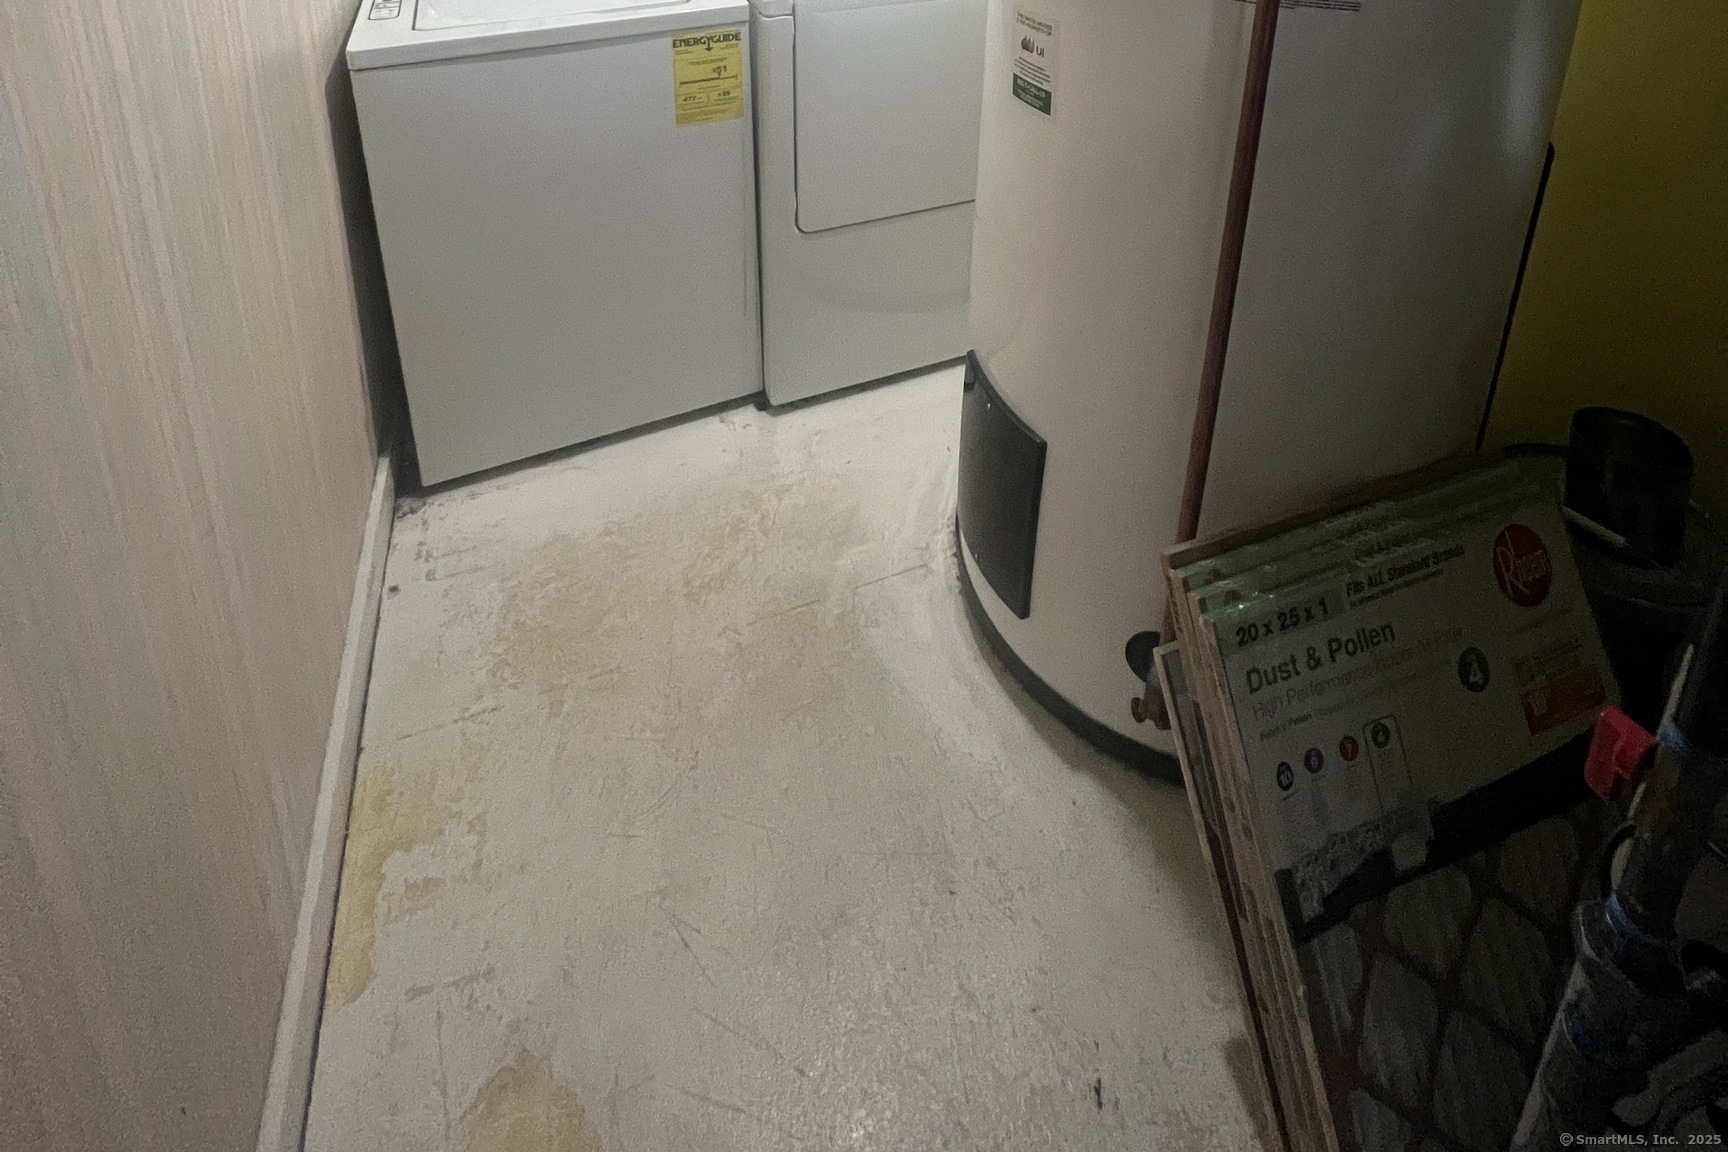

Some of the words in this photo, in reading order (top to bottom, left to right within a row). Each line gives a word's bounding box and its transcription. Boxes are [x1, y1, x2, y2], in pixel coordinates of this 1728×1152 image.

[672, 32, 741, 51] ENERGYGUIDE
[1036, 45, 1045, 58] UI
[1236, 622, 1259, 648] 20
[1263, 621, 1274, 638] x
[1278, 606, 1300, 632] 25
[1304, 604, 1315, 623] x
[1318, 598, 1328, 616] 1
[1246, 655, 1301, 695] Dust
[1306, 647, 1321, 672] &
[1327, 623, 1396, 664] Pollen
